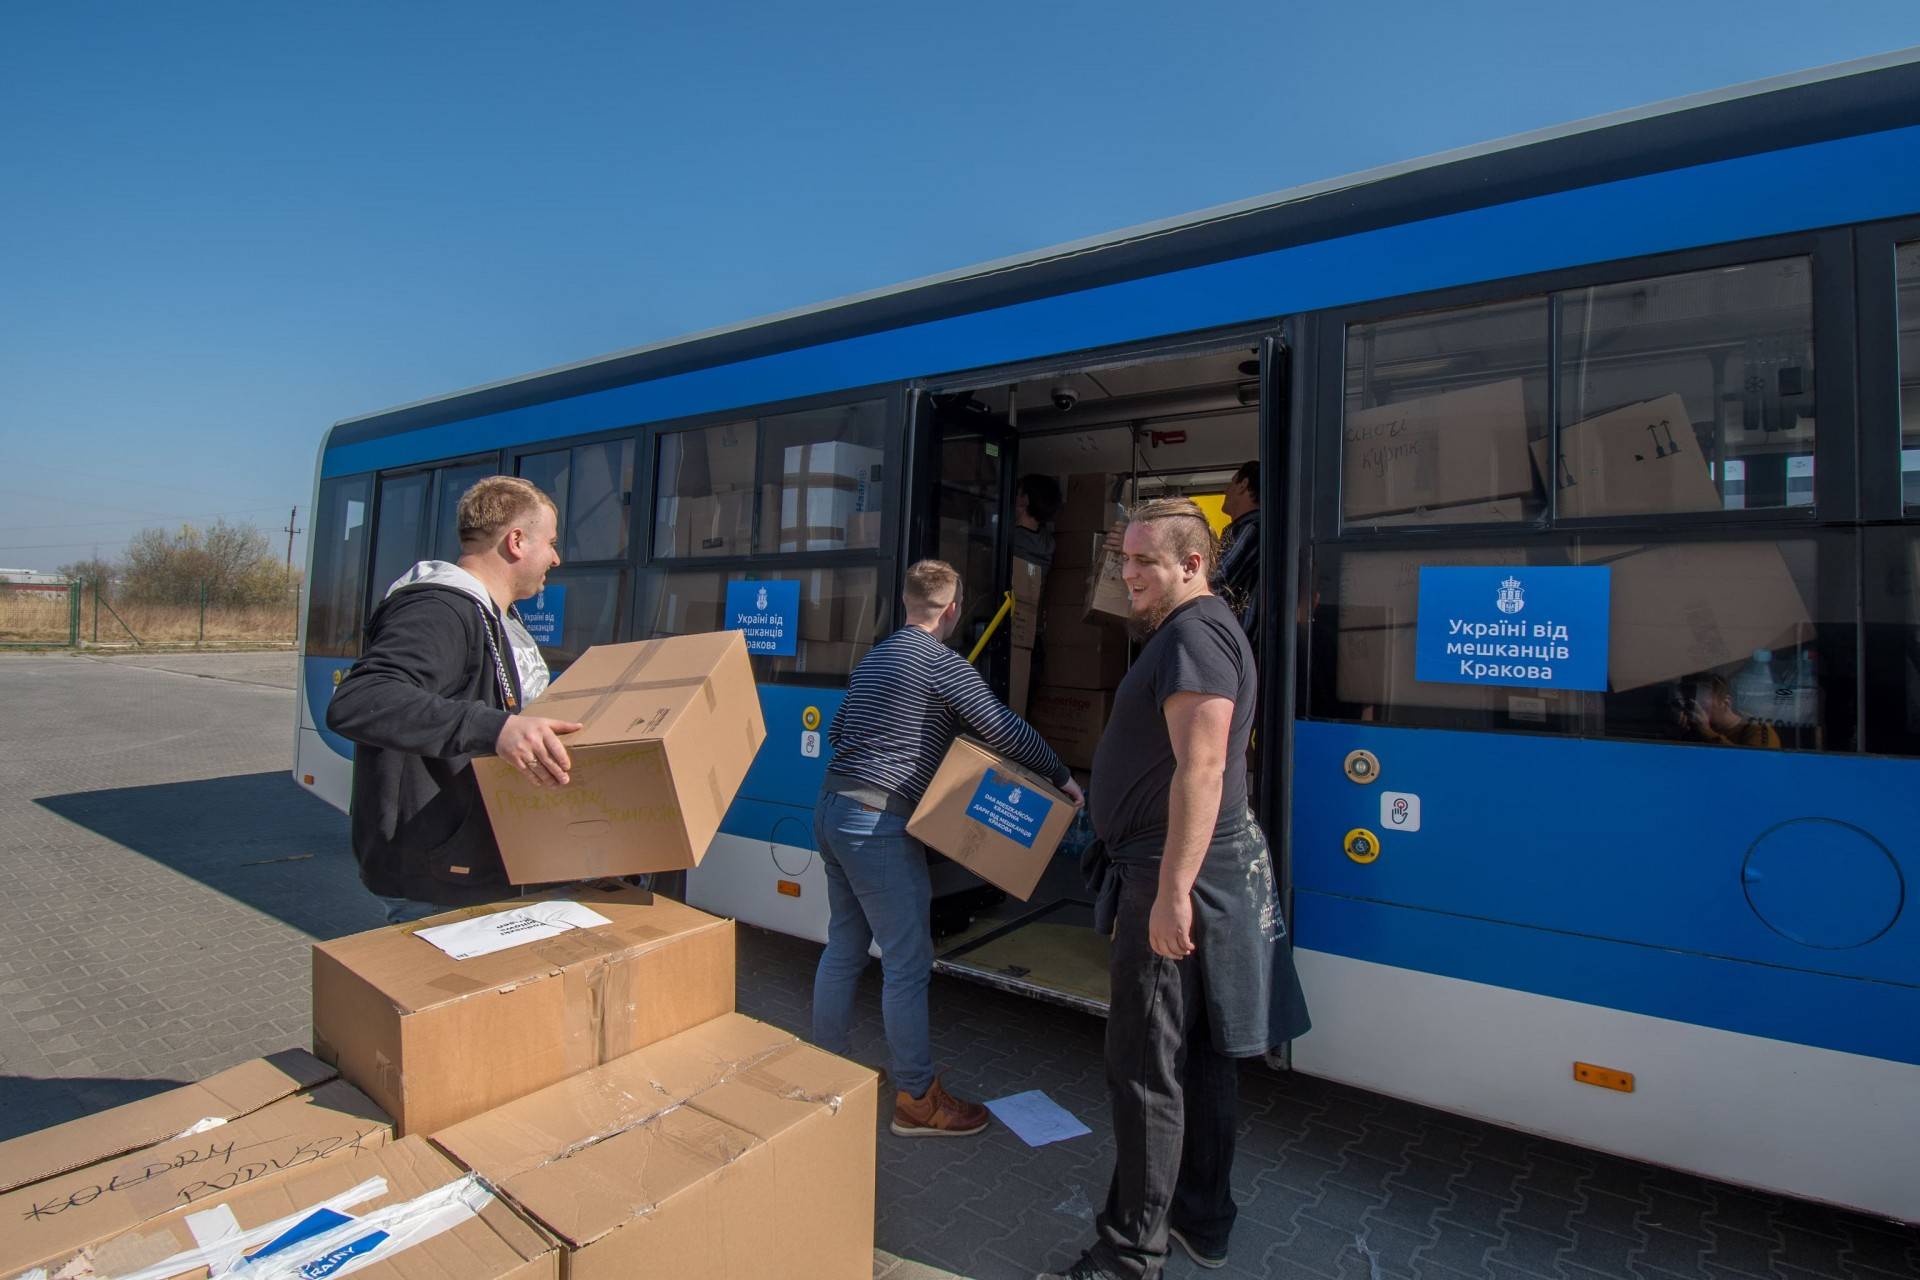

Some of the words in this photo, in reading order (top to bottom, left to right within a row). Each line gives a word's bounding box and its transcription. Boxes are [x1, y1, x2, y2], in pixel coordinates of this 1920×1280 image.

[526, 622, 554, 632] ешканців
[737, 612, 768, 625] Україні
[769, 613, 783, 626] від
[739, 627, 783, 640] ешканців
[1448, 619, 1527, 639] Україні
[1533, 620, 1569, 641] від
[747, 640, 777, 650] ракова
[1446, 641, 1569, 661] мешканців
[1460, 659, 1552, 679] Кракова
[304, 1246, 355, 1279] RAINY
